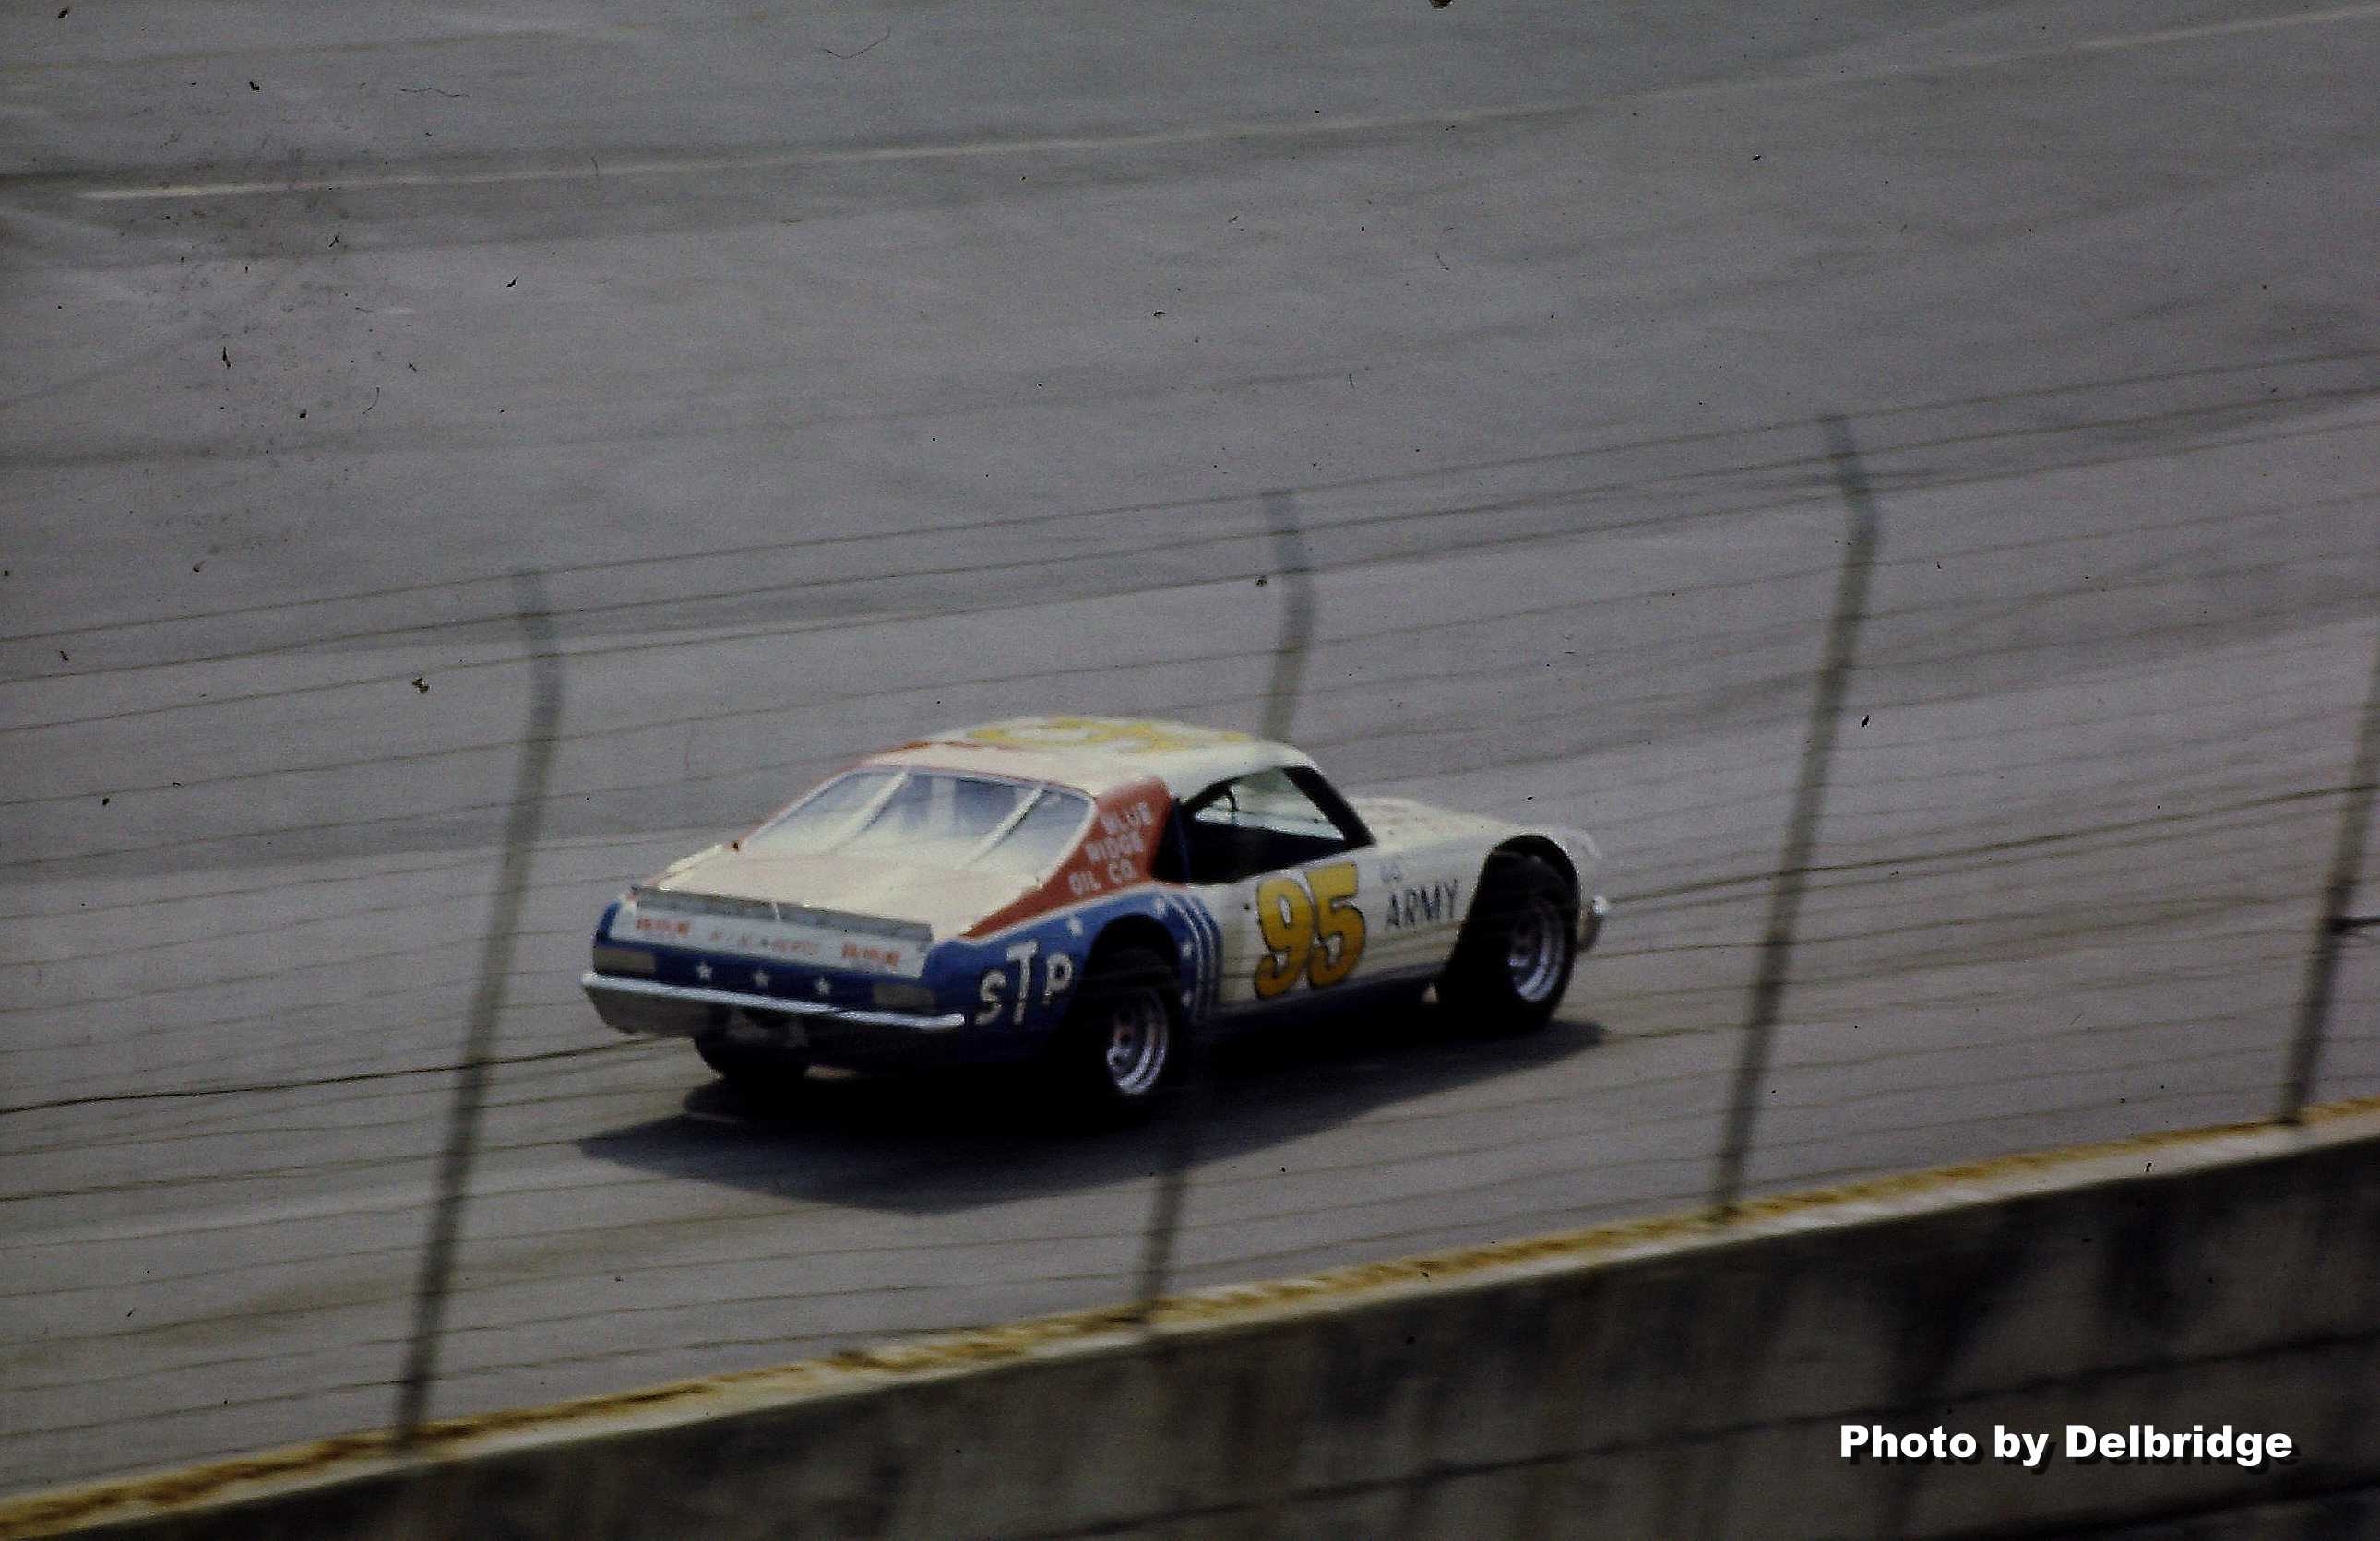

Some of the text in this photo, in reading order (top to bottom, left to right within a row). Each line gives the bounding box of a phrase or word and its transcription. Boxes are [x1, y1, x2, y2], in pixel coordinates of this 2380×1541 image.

[1068, 870, 1102, 895] OIL
[1386, 877, 1460, 928] ARMY
[1254, 861, 1366, 1000] 95
[975, 940, 1073, 1026] STP
